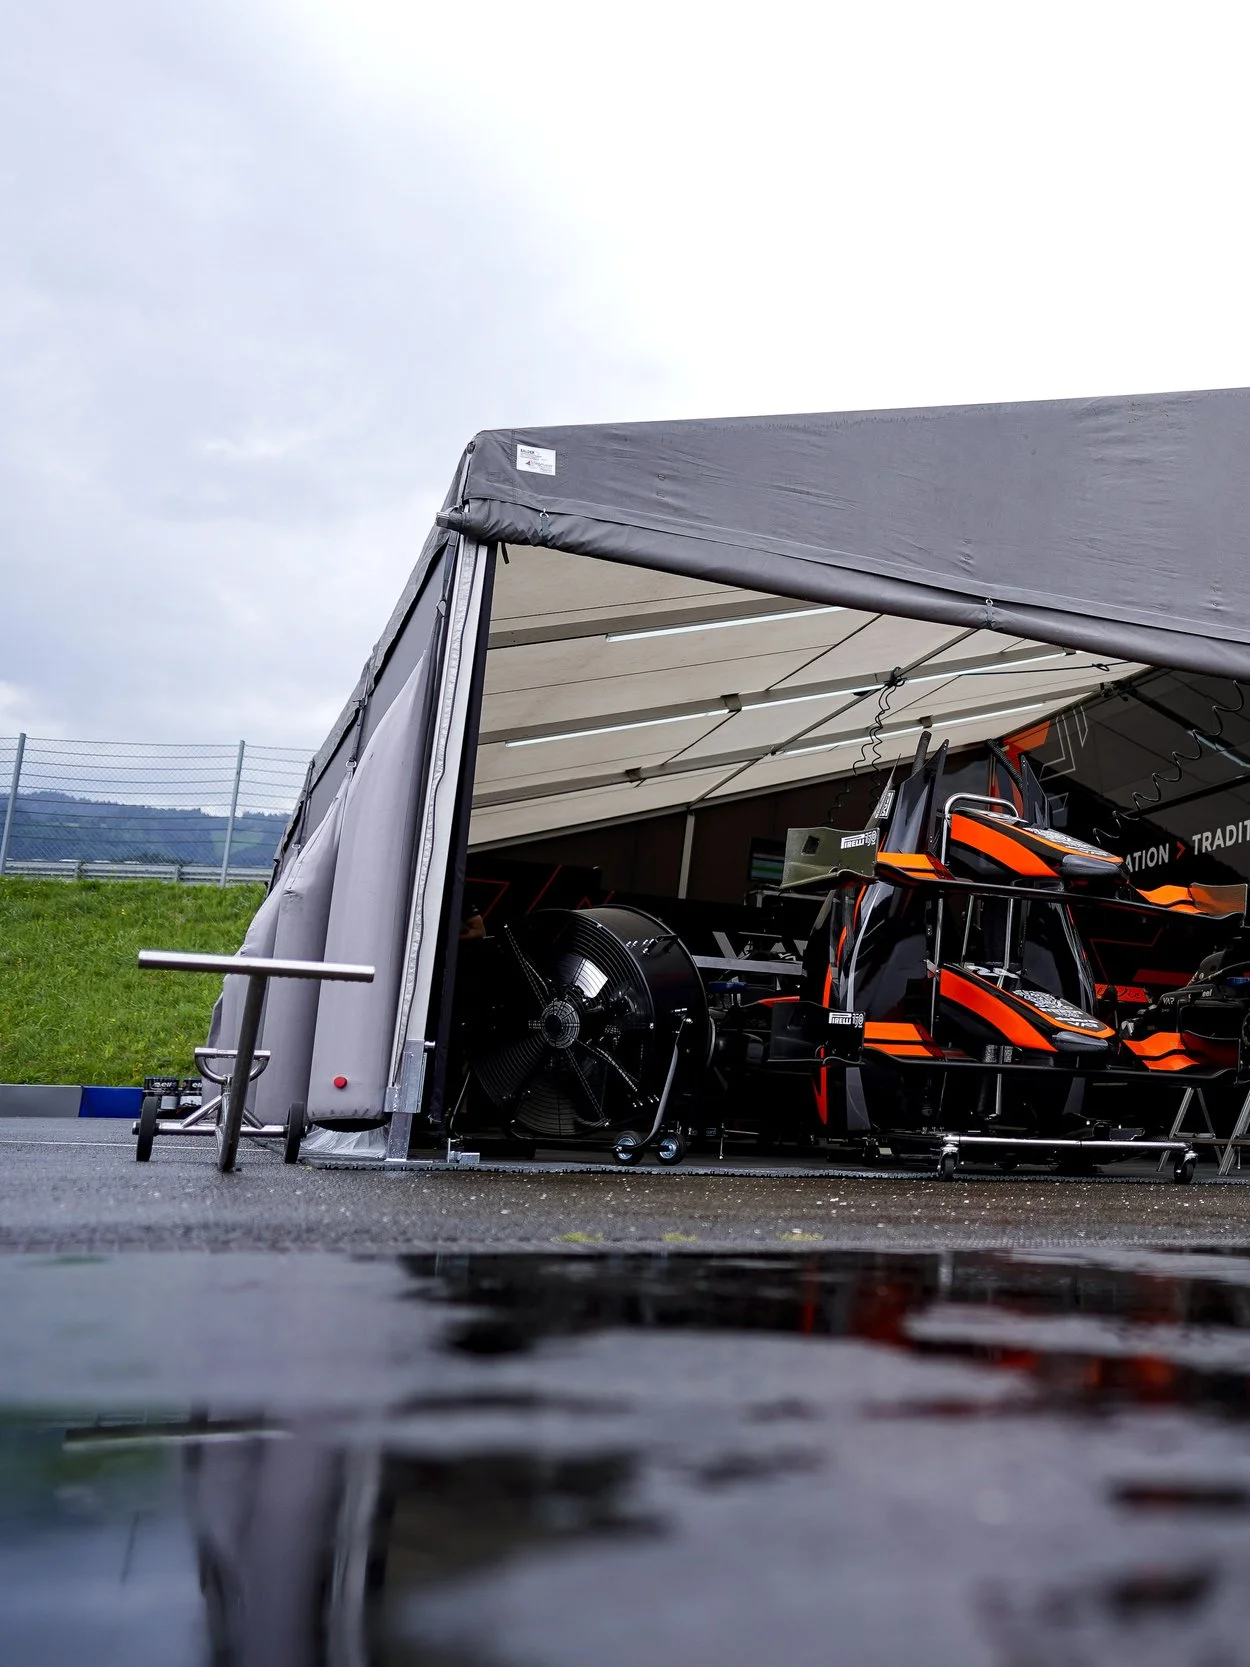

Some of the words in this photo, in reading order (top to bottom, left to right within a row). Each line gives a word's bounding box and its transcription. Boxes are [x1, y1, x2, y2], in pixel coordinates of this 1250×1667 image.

[840, 834, 865, 849] PIRELLI
[1125, 843, 1170, 874] ATION
[828, 1012, 852, 1025] PIRELLI
